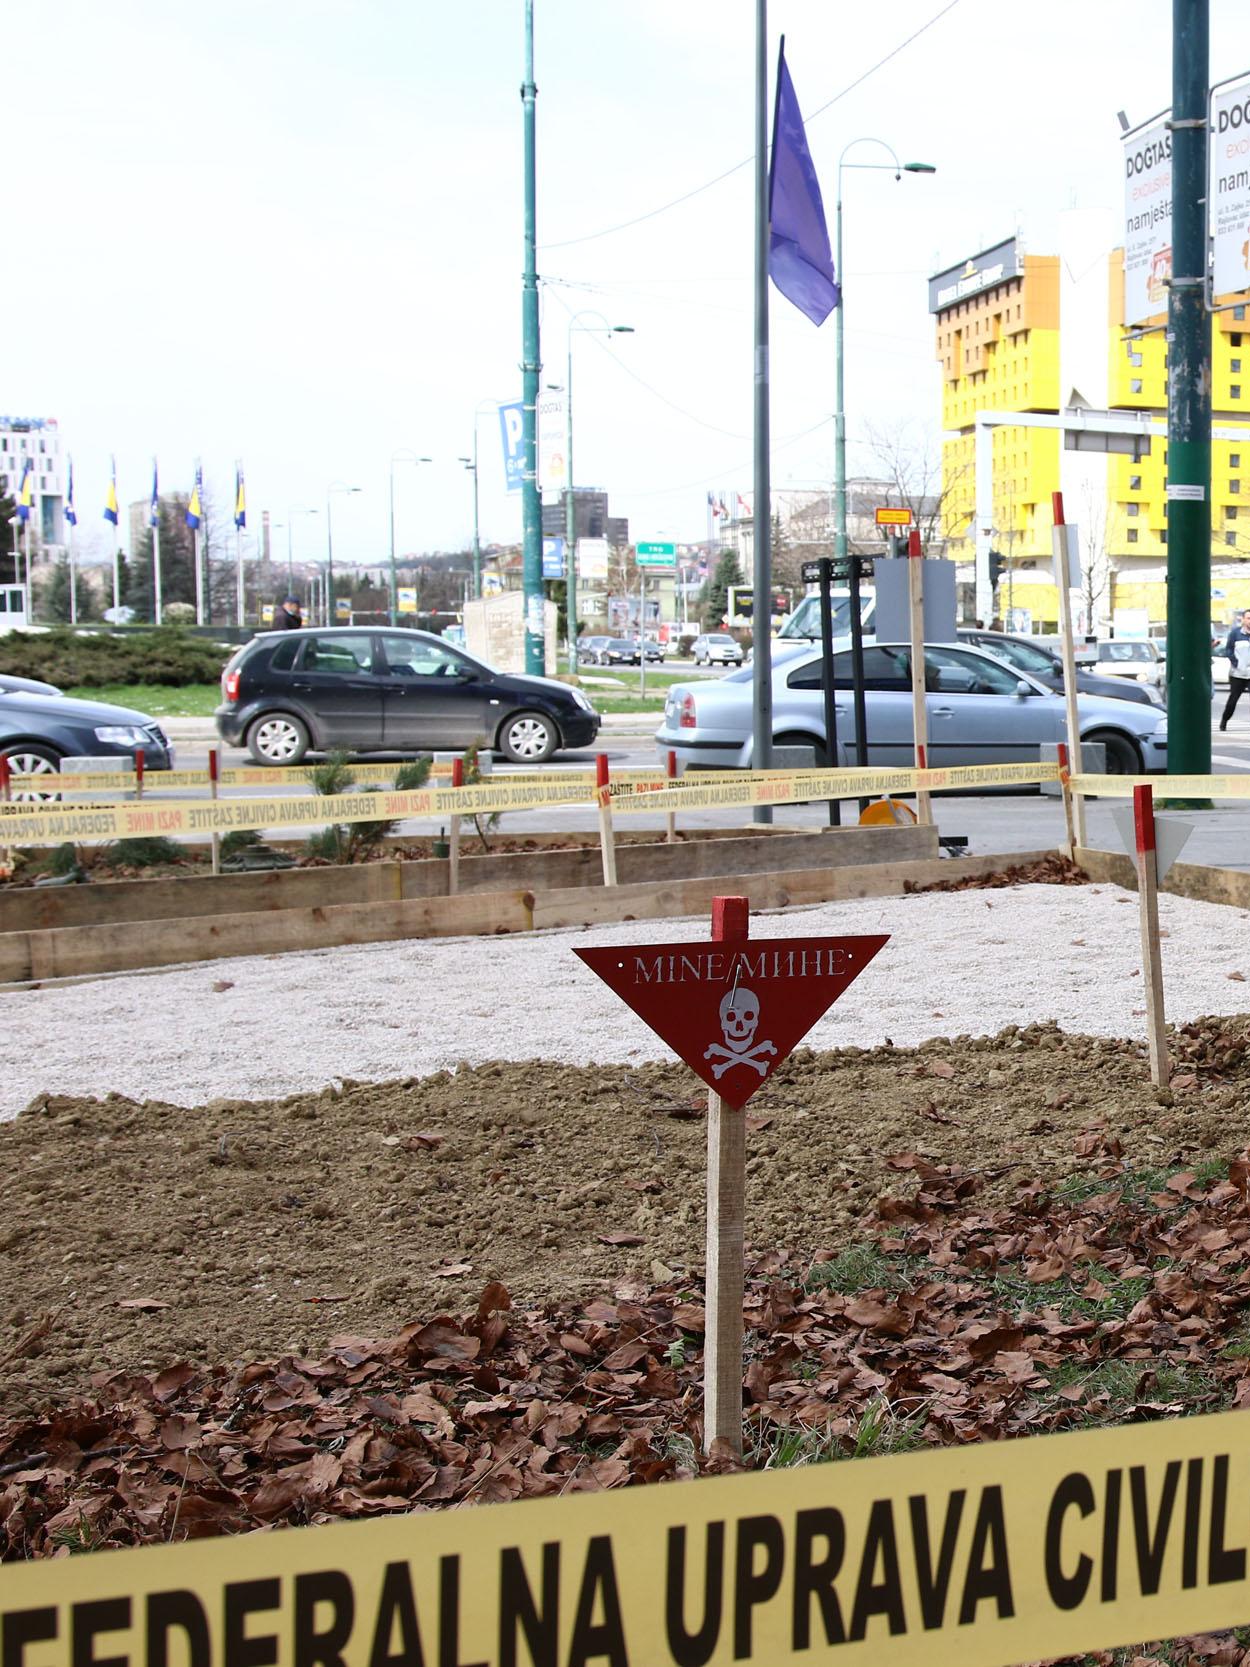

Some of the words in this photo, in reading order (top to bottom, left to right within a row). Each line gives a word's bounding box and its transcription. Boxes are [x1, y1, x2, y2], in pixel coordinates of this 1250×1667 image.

[1126, 200, 1174, 234] namješta
[503, 408, 523, 457] P
[609, 779, 633, 797] ZAŠTITE
[665, 1484, 1017, 1667] UPRAVA
